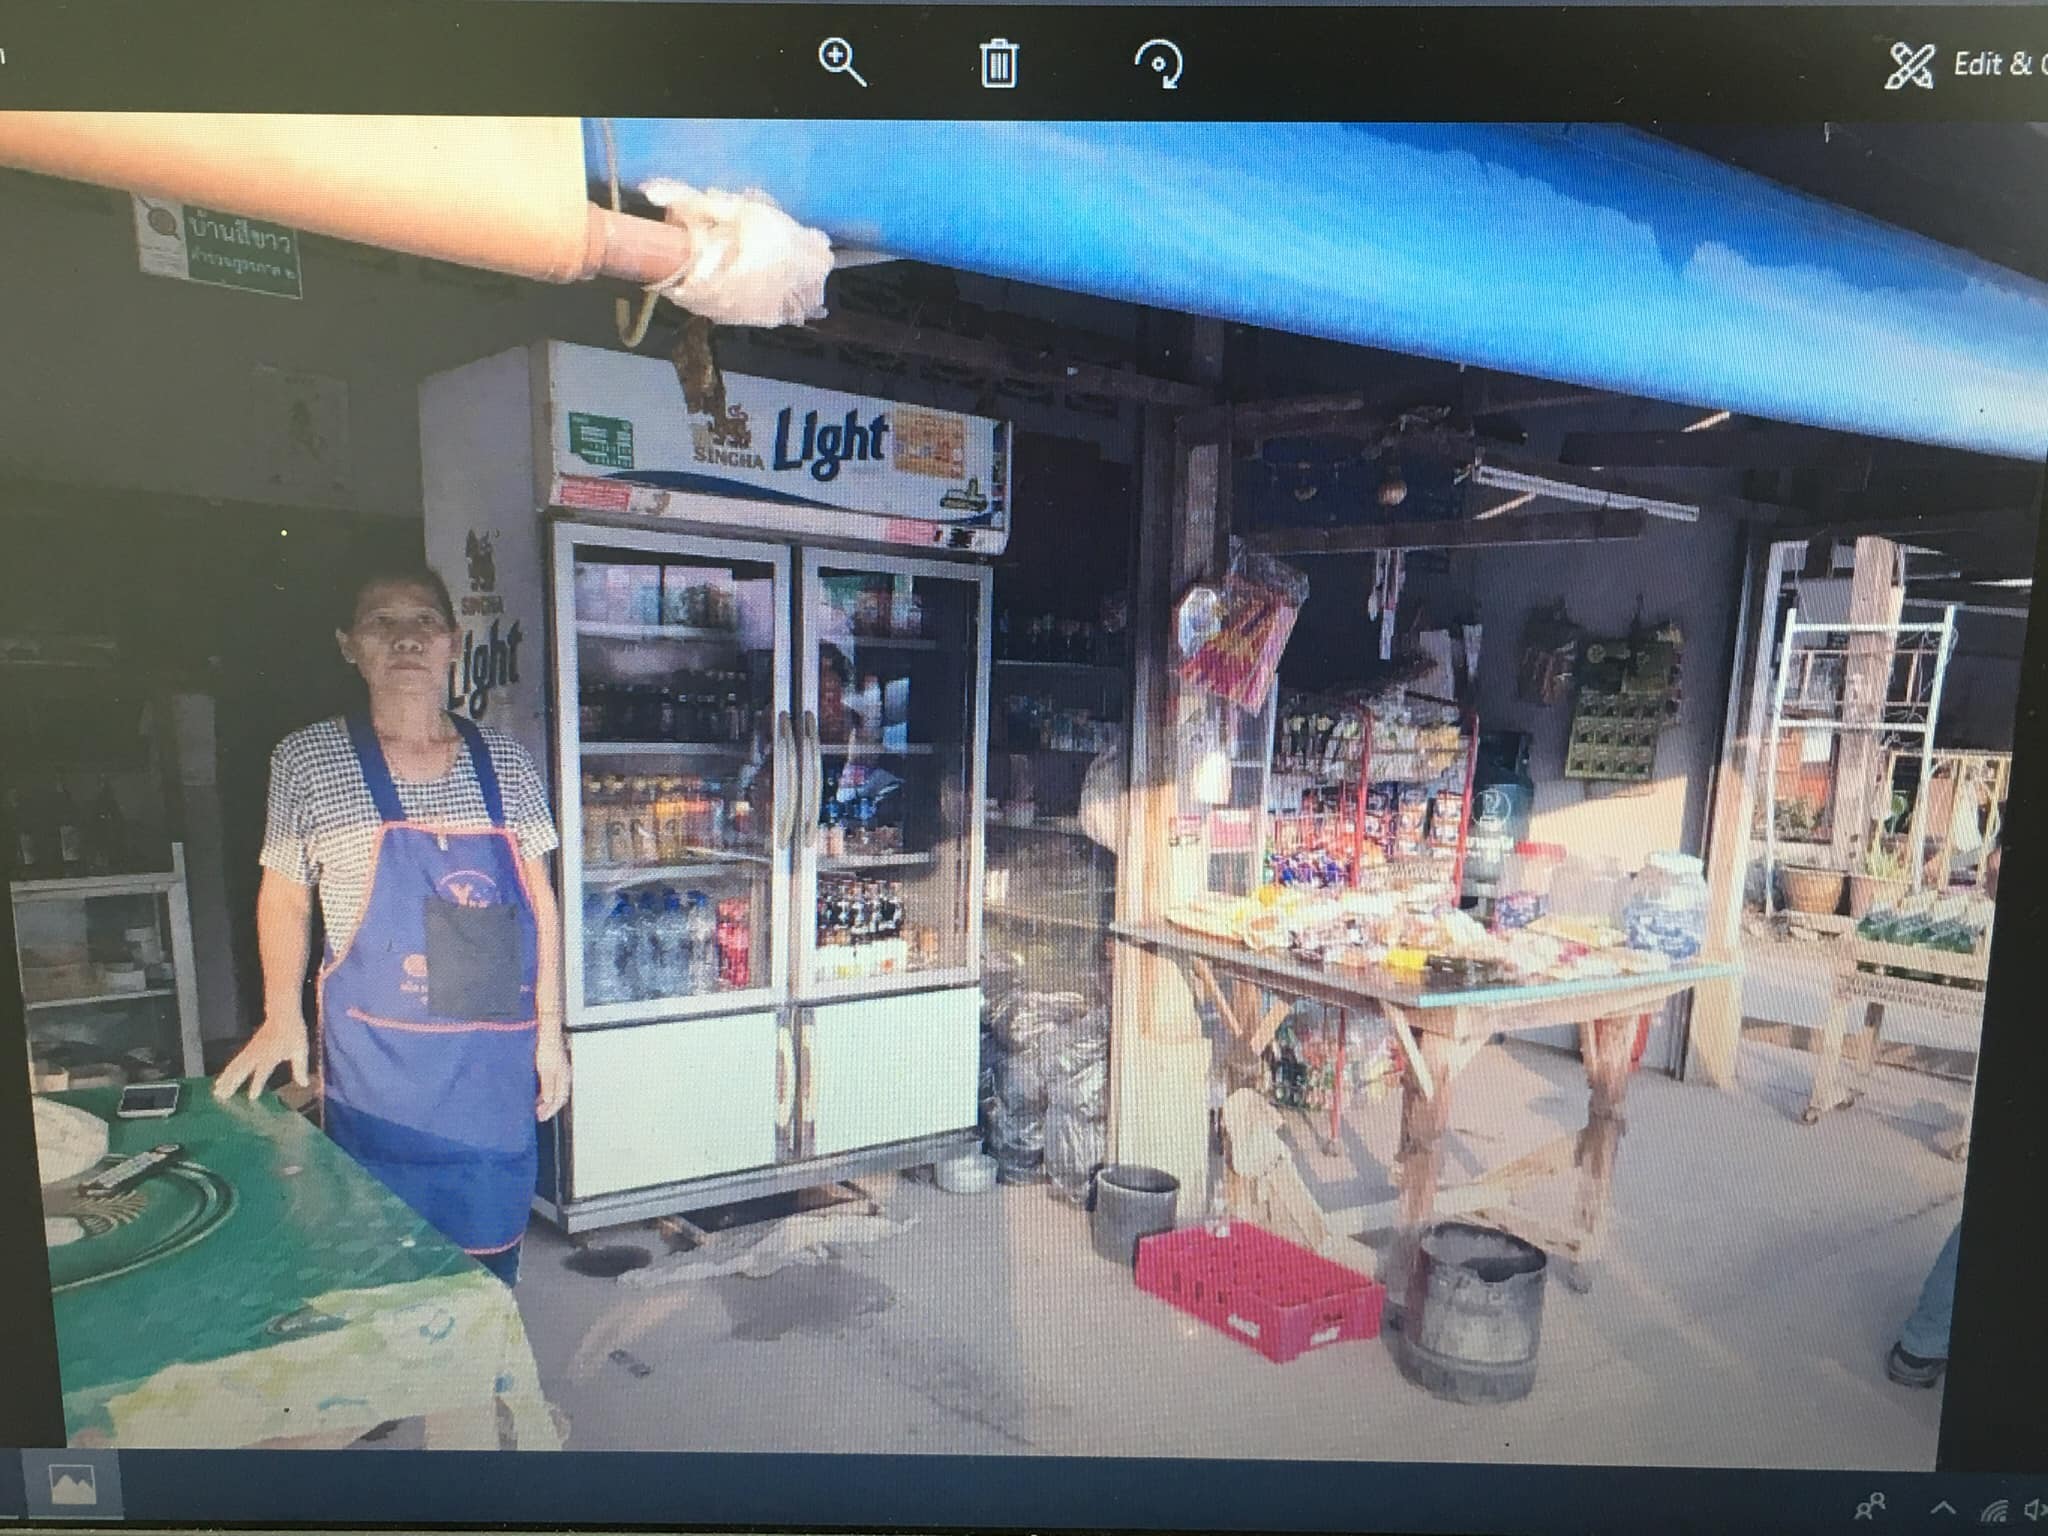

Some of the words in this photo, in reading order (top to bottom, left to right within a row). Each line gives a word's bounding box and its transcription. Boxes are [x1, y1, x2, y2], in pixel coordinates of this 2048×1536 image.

[1955, 50, 2003, 75] Edit
[2010, 51, 2033, 75] &
[773, 407, 889, 482] Light
[693, 446, 764, 471] SINGHA
